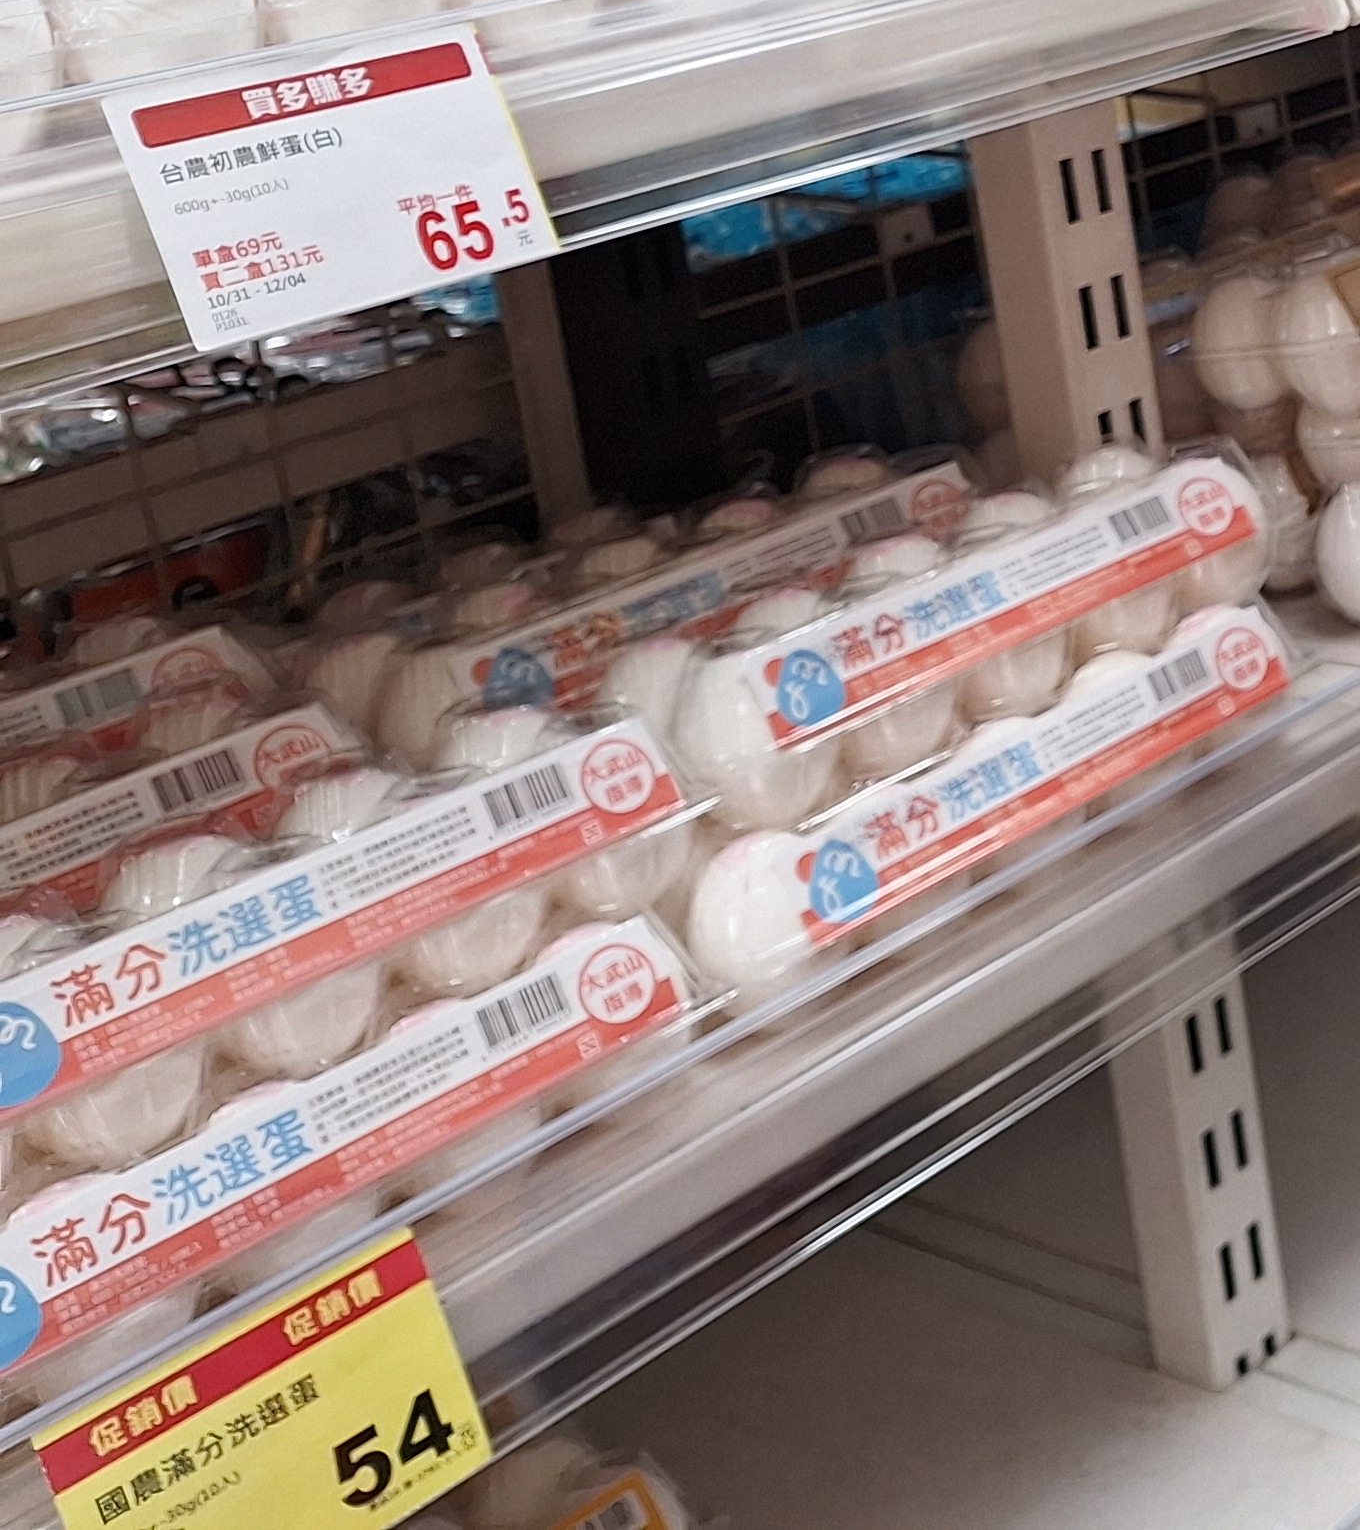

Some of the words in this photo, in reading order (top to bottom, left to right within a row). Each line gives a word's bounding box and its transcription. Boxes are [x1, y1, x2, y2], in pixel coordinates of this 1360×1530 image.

[241, 67, 373, 121] 買多賺多
[159, 125, 344, 186] 台農初農鮮蛋(白)
[397, 182, 474, 217] 平均一件
[414, 199, 495, 274] 65
[516, 229, 534, 247] 元
[206, 285, 252, 310] 10/31
[263, 272, 307, 296] 12/04
[831, 569, 1008, 669] 滿分洗選蛋
[49, 873, 325, 1030] 滿分洗選蛋
[30, 1108, 313, 1288] 滿分洗選蛋
[86, 1373, 201, 1457] 促銷價
[279, 1268, 386, 1346] 促銷價
[95, 1373, 322, 1525] 國農滿分洗選蛋
[332, 1388, 454, 1508] 54
